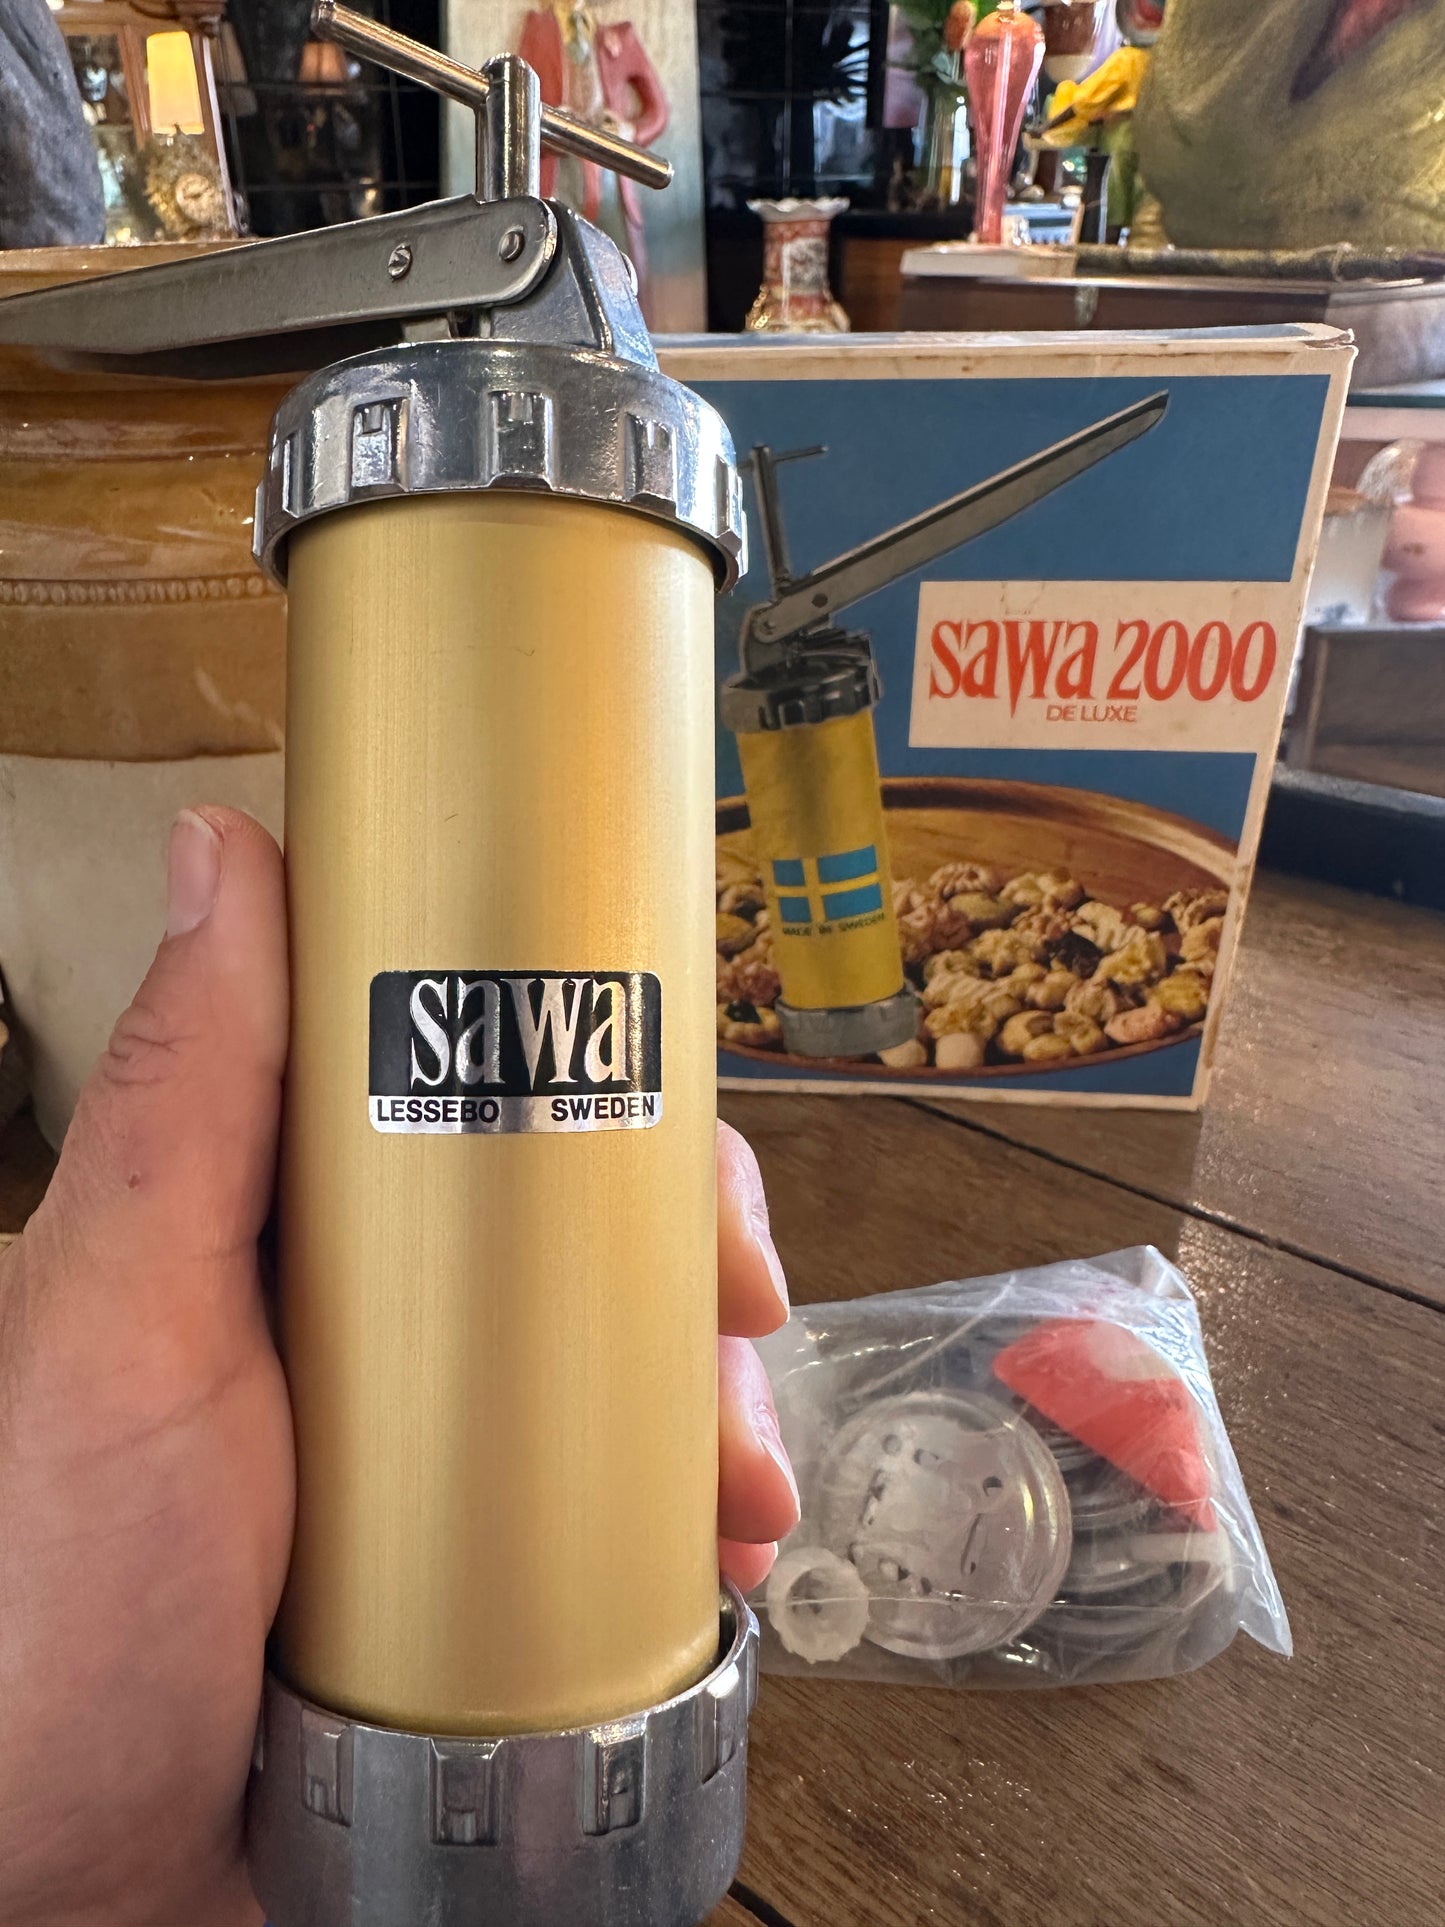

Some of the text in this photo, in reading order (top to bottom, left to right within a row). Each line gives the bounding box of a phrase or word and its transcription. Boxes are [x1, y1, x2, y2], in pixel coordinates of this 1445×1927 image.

[1107, 618, 1277, 702] 2000
[1045, 704, 1138, 722] DE LUXE
[377, 1095, 655, 1123] LESSEBO SWEDEN
